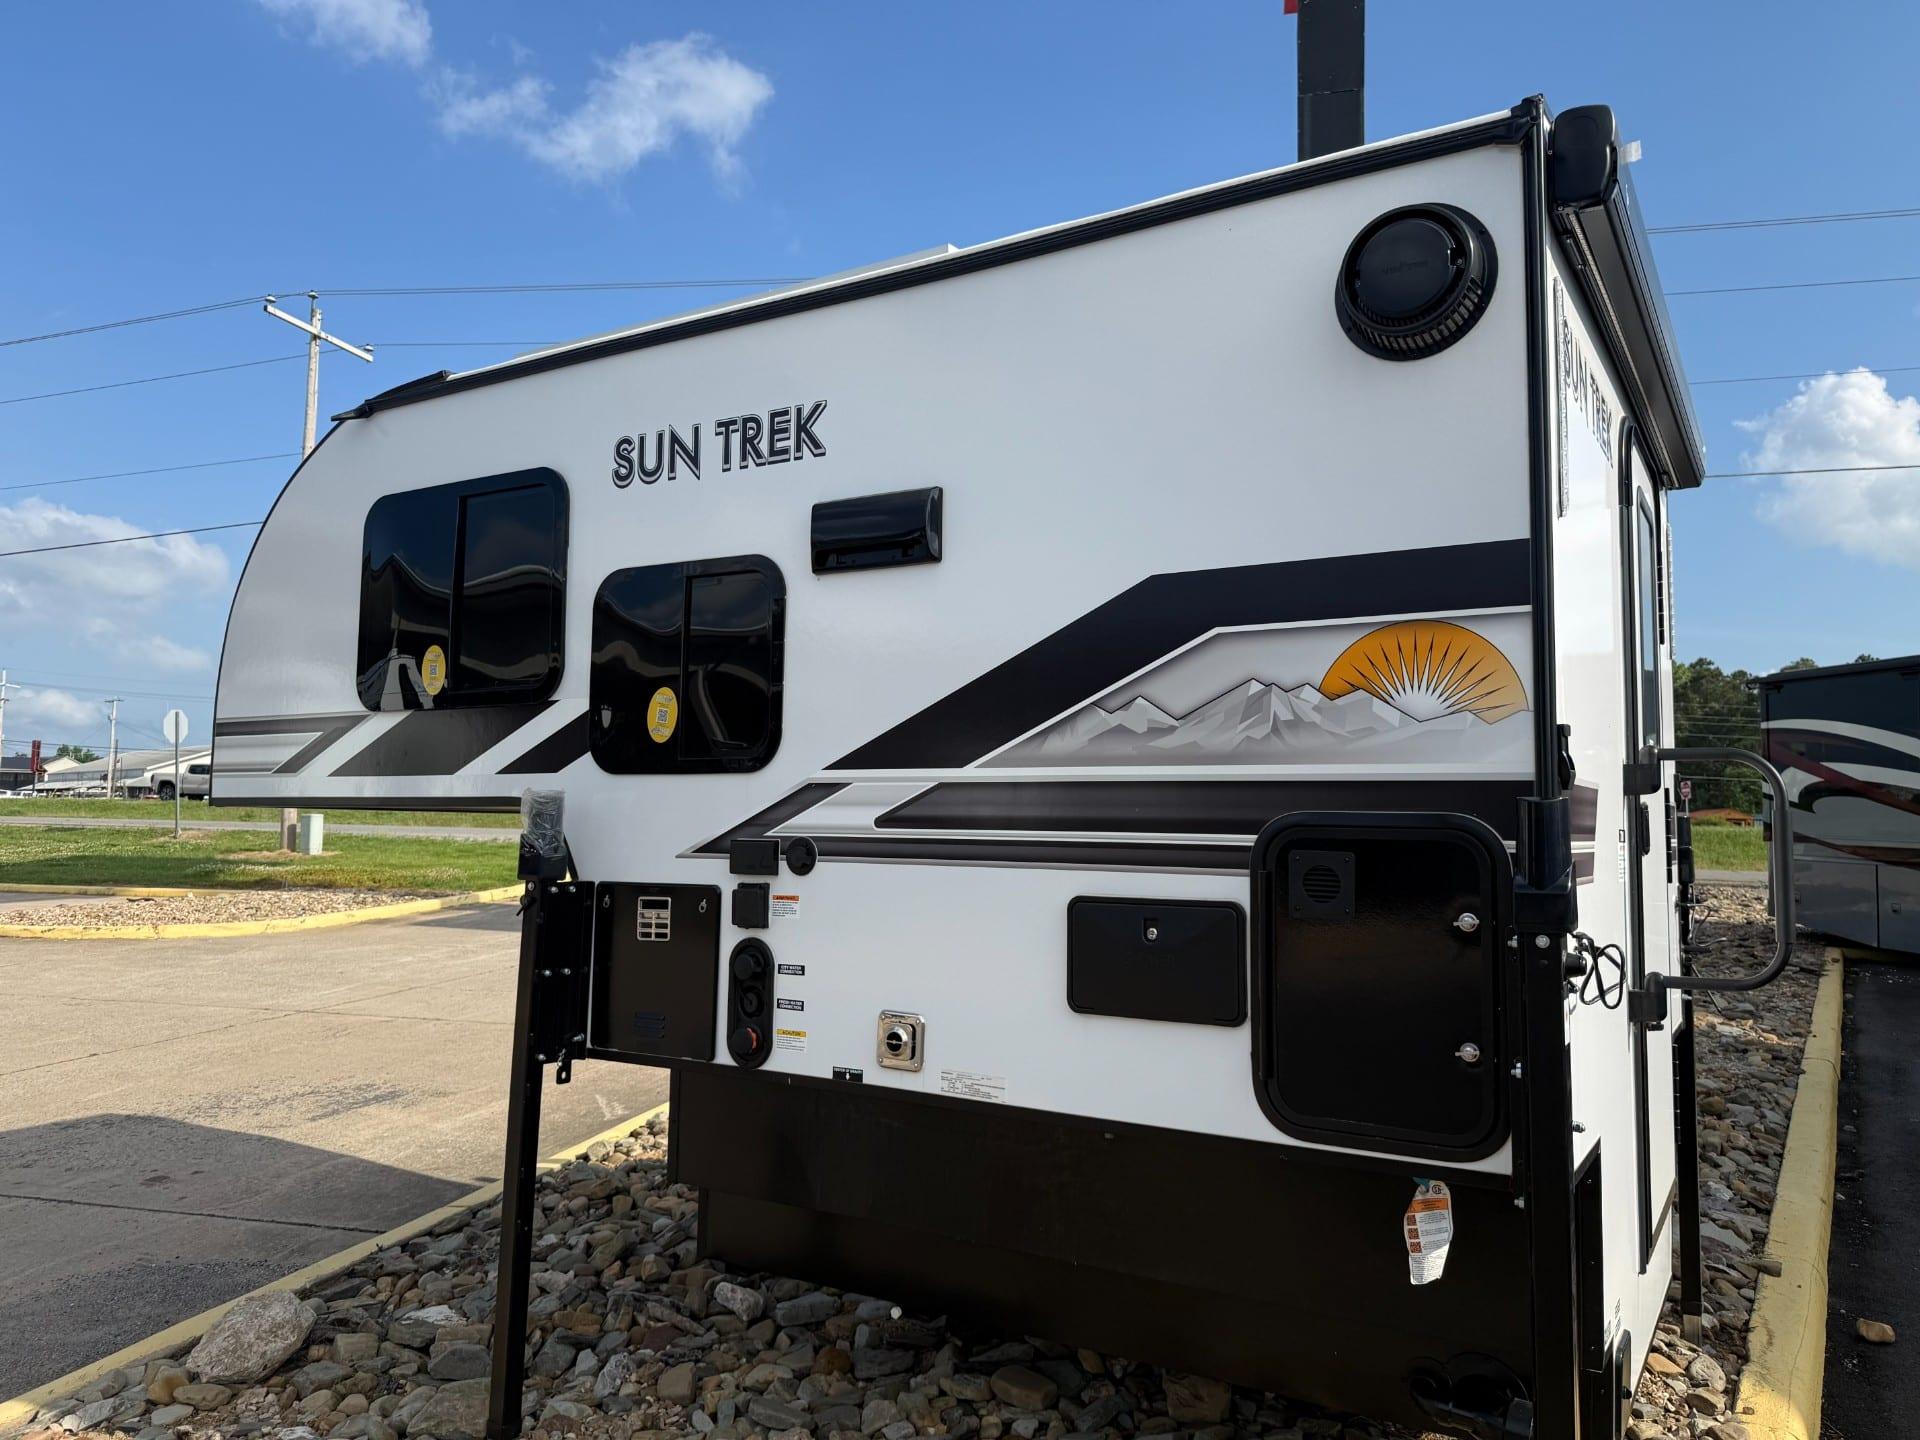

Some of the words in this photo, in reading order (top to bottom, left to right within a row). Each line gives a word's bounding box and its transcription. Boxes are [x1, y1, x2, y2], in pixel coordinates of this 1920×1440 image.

[612, 422, 702, 489] SUN
[714, 399, 828, 473] TREK
[1589, 367, 1614, 469] TREK
